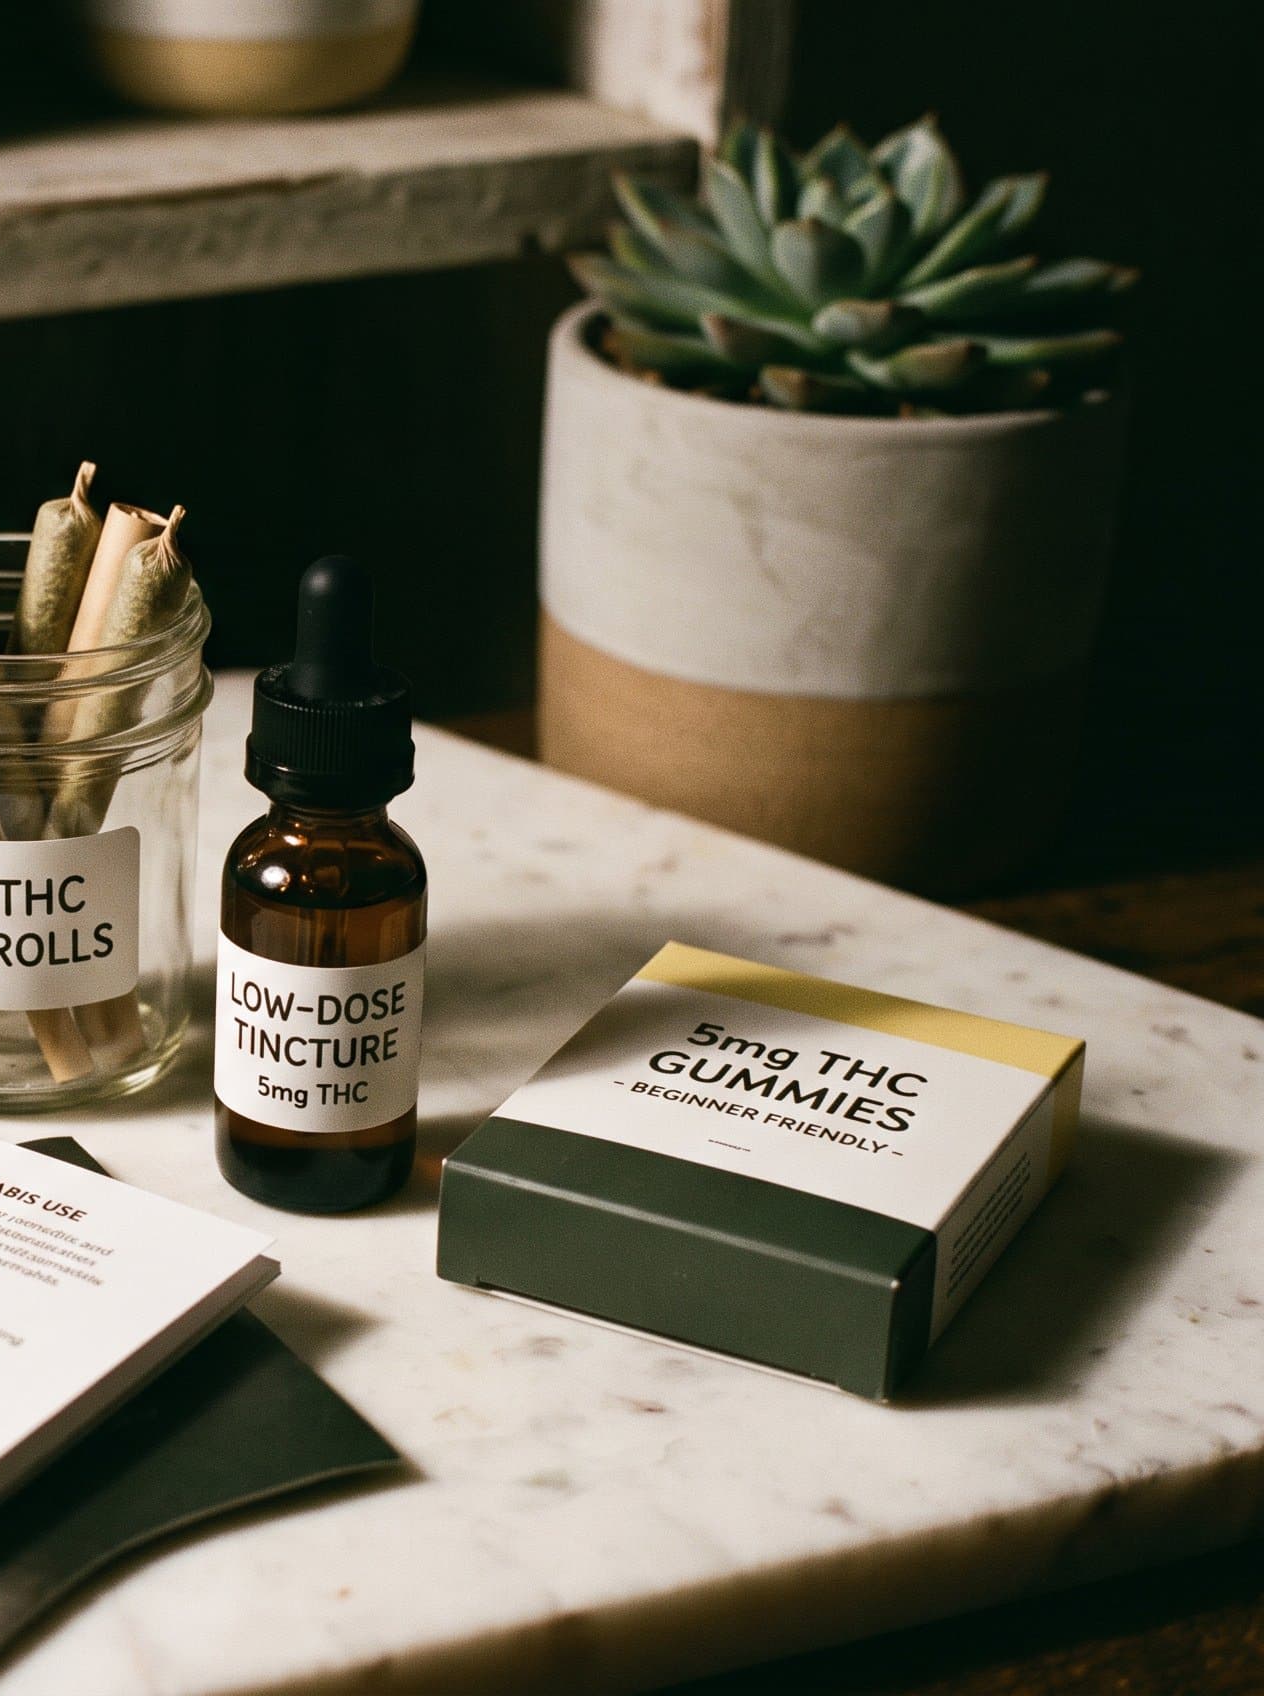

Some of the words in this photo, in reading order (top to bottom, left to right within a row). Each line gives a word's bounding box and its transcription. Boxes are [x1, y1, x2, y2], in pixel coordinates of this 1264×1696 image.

[231, 971, 406, 1027] LOW-DOSE
[234, 1017, 399, 1070] TINCTURE
[686, 1021, 799, 1071] 5mg
[818, 1050, 929, 1099] THC
[257, 1075, 309, 1109] 5mg
[316, 1080, 370, 1106] THC
[631, 1080, 759, 1121] BEGINNER
[762, 1112, 889, 1155] FRIENDLY
[648, 1050, 917, 1133] GUMMIES
[42, 1199, 89, 1223] USE
